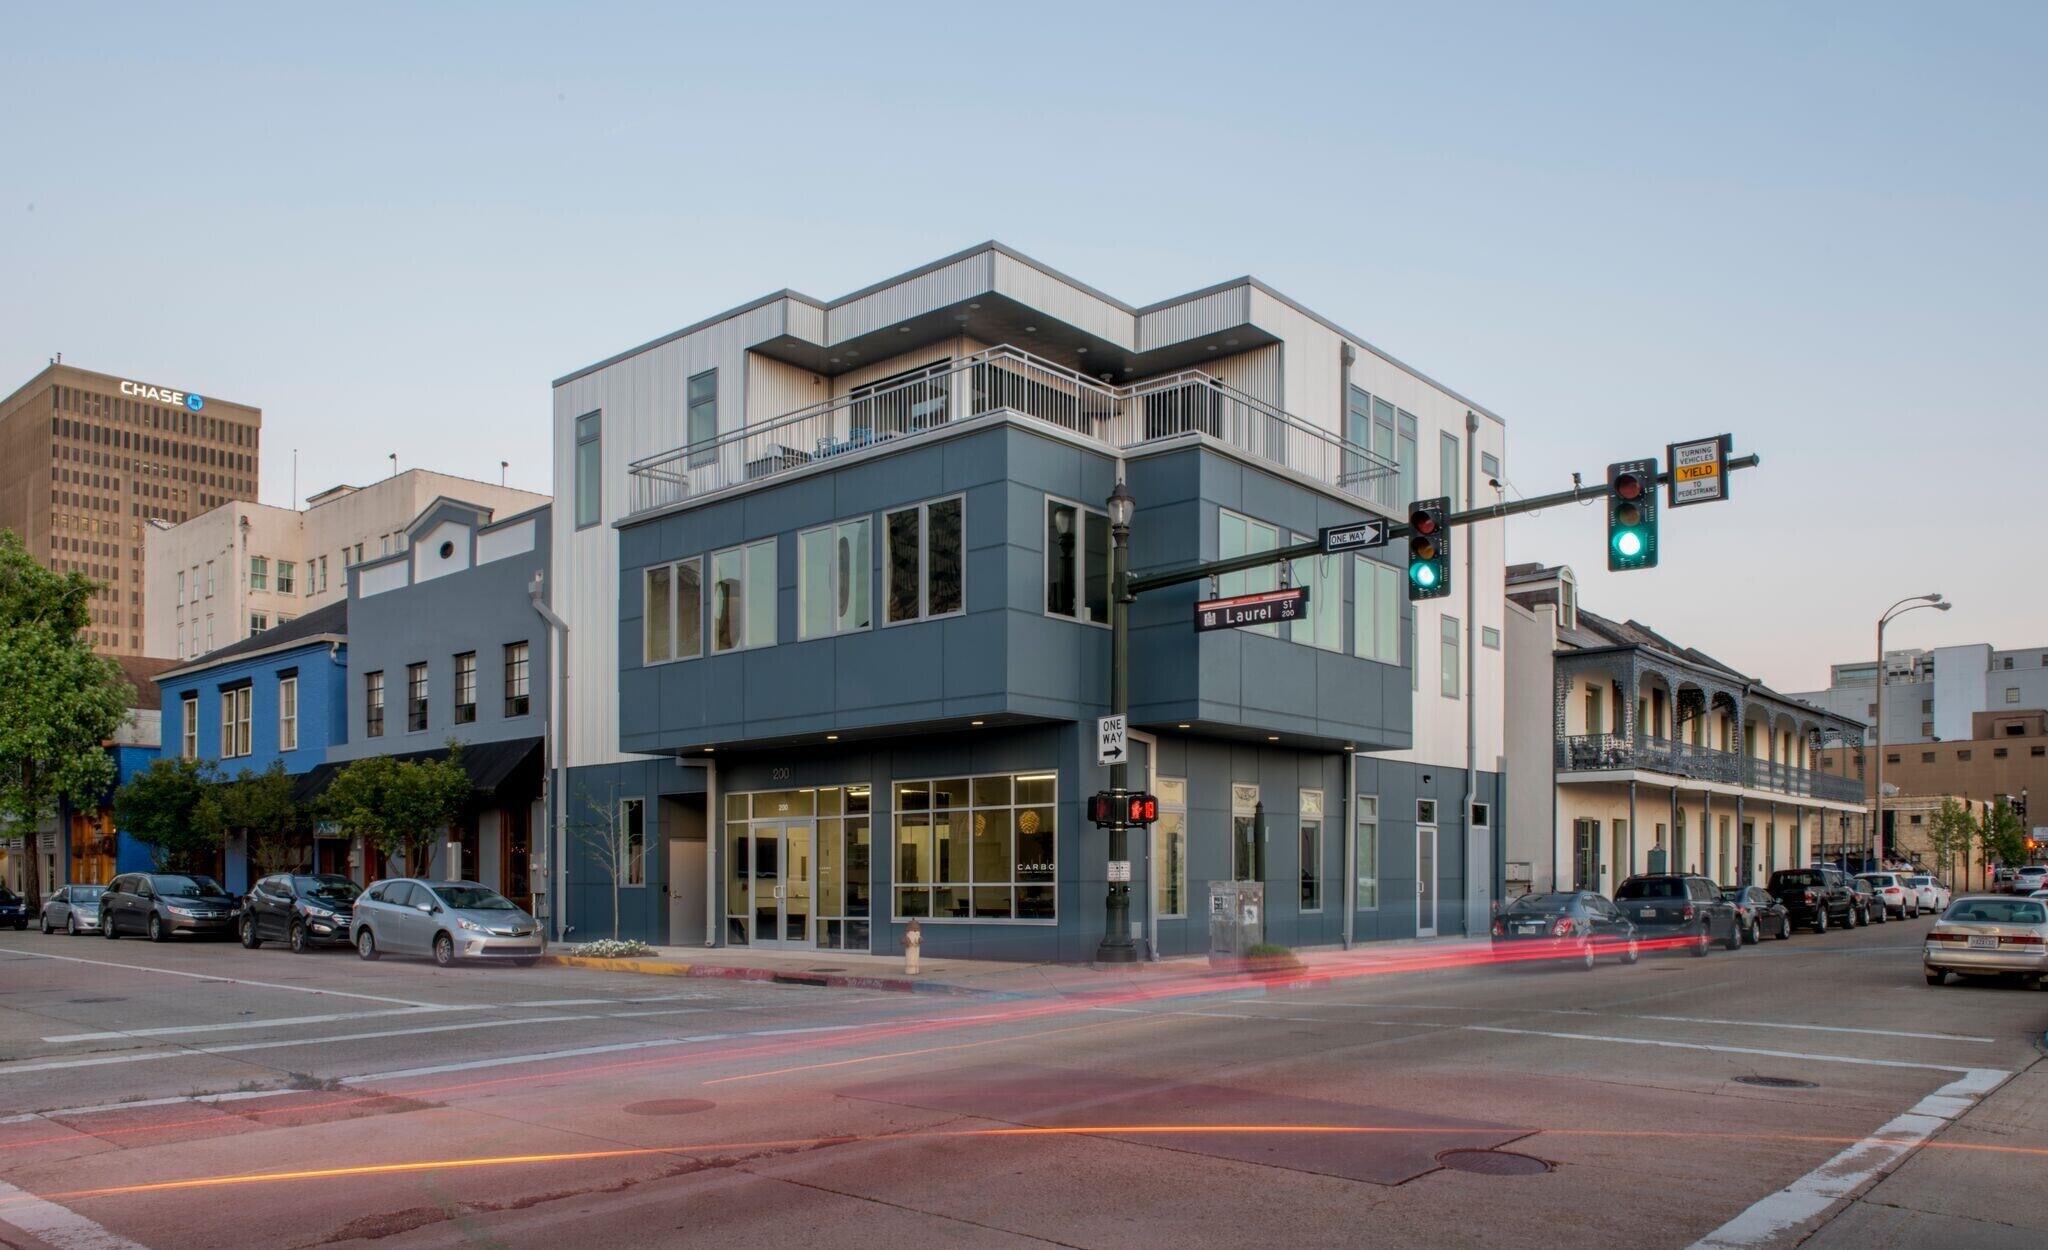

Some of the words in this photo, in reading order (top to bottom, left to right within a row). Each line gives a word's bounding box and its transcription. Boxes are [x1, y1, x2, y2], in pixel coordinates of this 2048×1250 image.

[121, 381, 184, 405] CHASE
[1681, 447, 1712, 457] TURNING
[1680, 454, 1714, 465] VEHICLES
[1682, 465, 1712, 478] YIELD
[1678, 487, 1716, 497] PEDESTRIANS
[1331, 533, 1347, 544] ONE
[1349, 531, 1366, 541] WAY
[1226, 604, 1272, 624] Laurel
[1283, 600, 1293, 609] ST
[1282, 609, 1294, 618] 200
[1103, 719, 1122, 731] ONE
[1103, 731, 1122, 744] WAY
[773, 768, 790, 780] 200
[1017, 863, 1055, 871] CARBO
